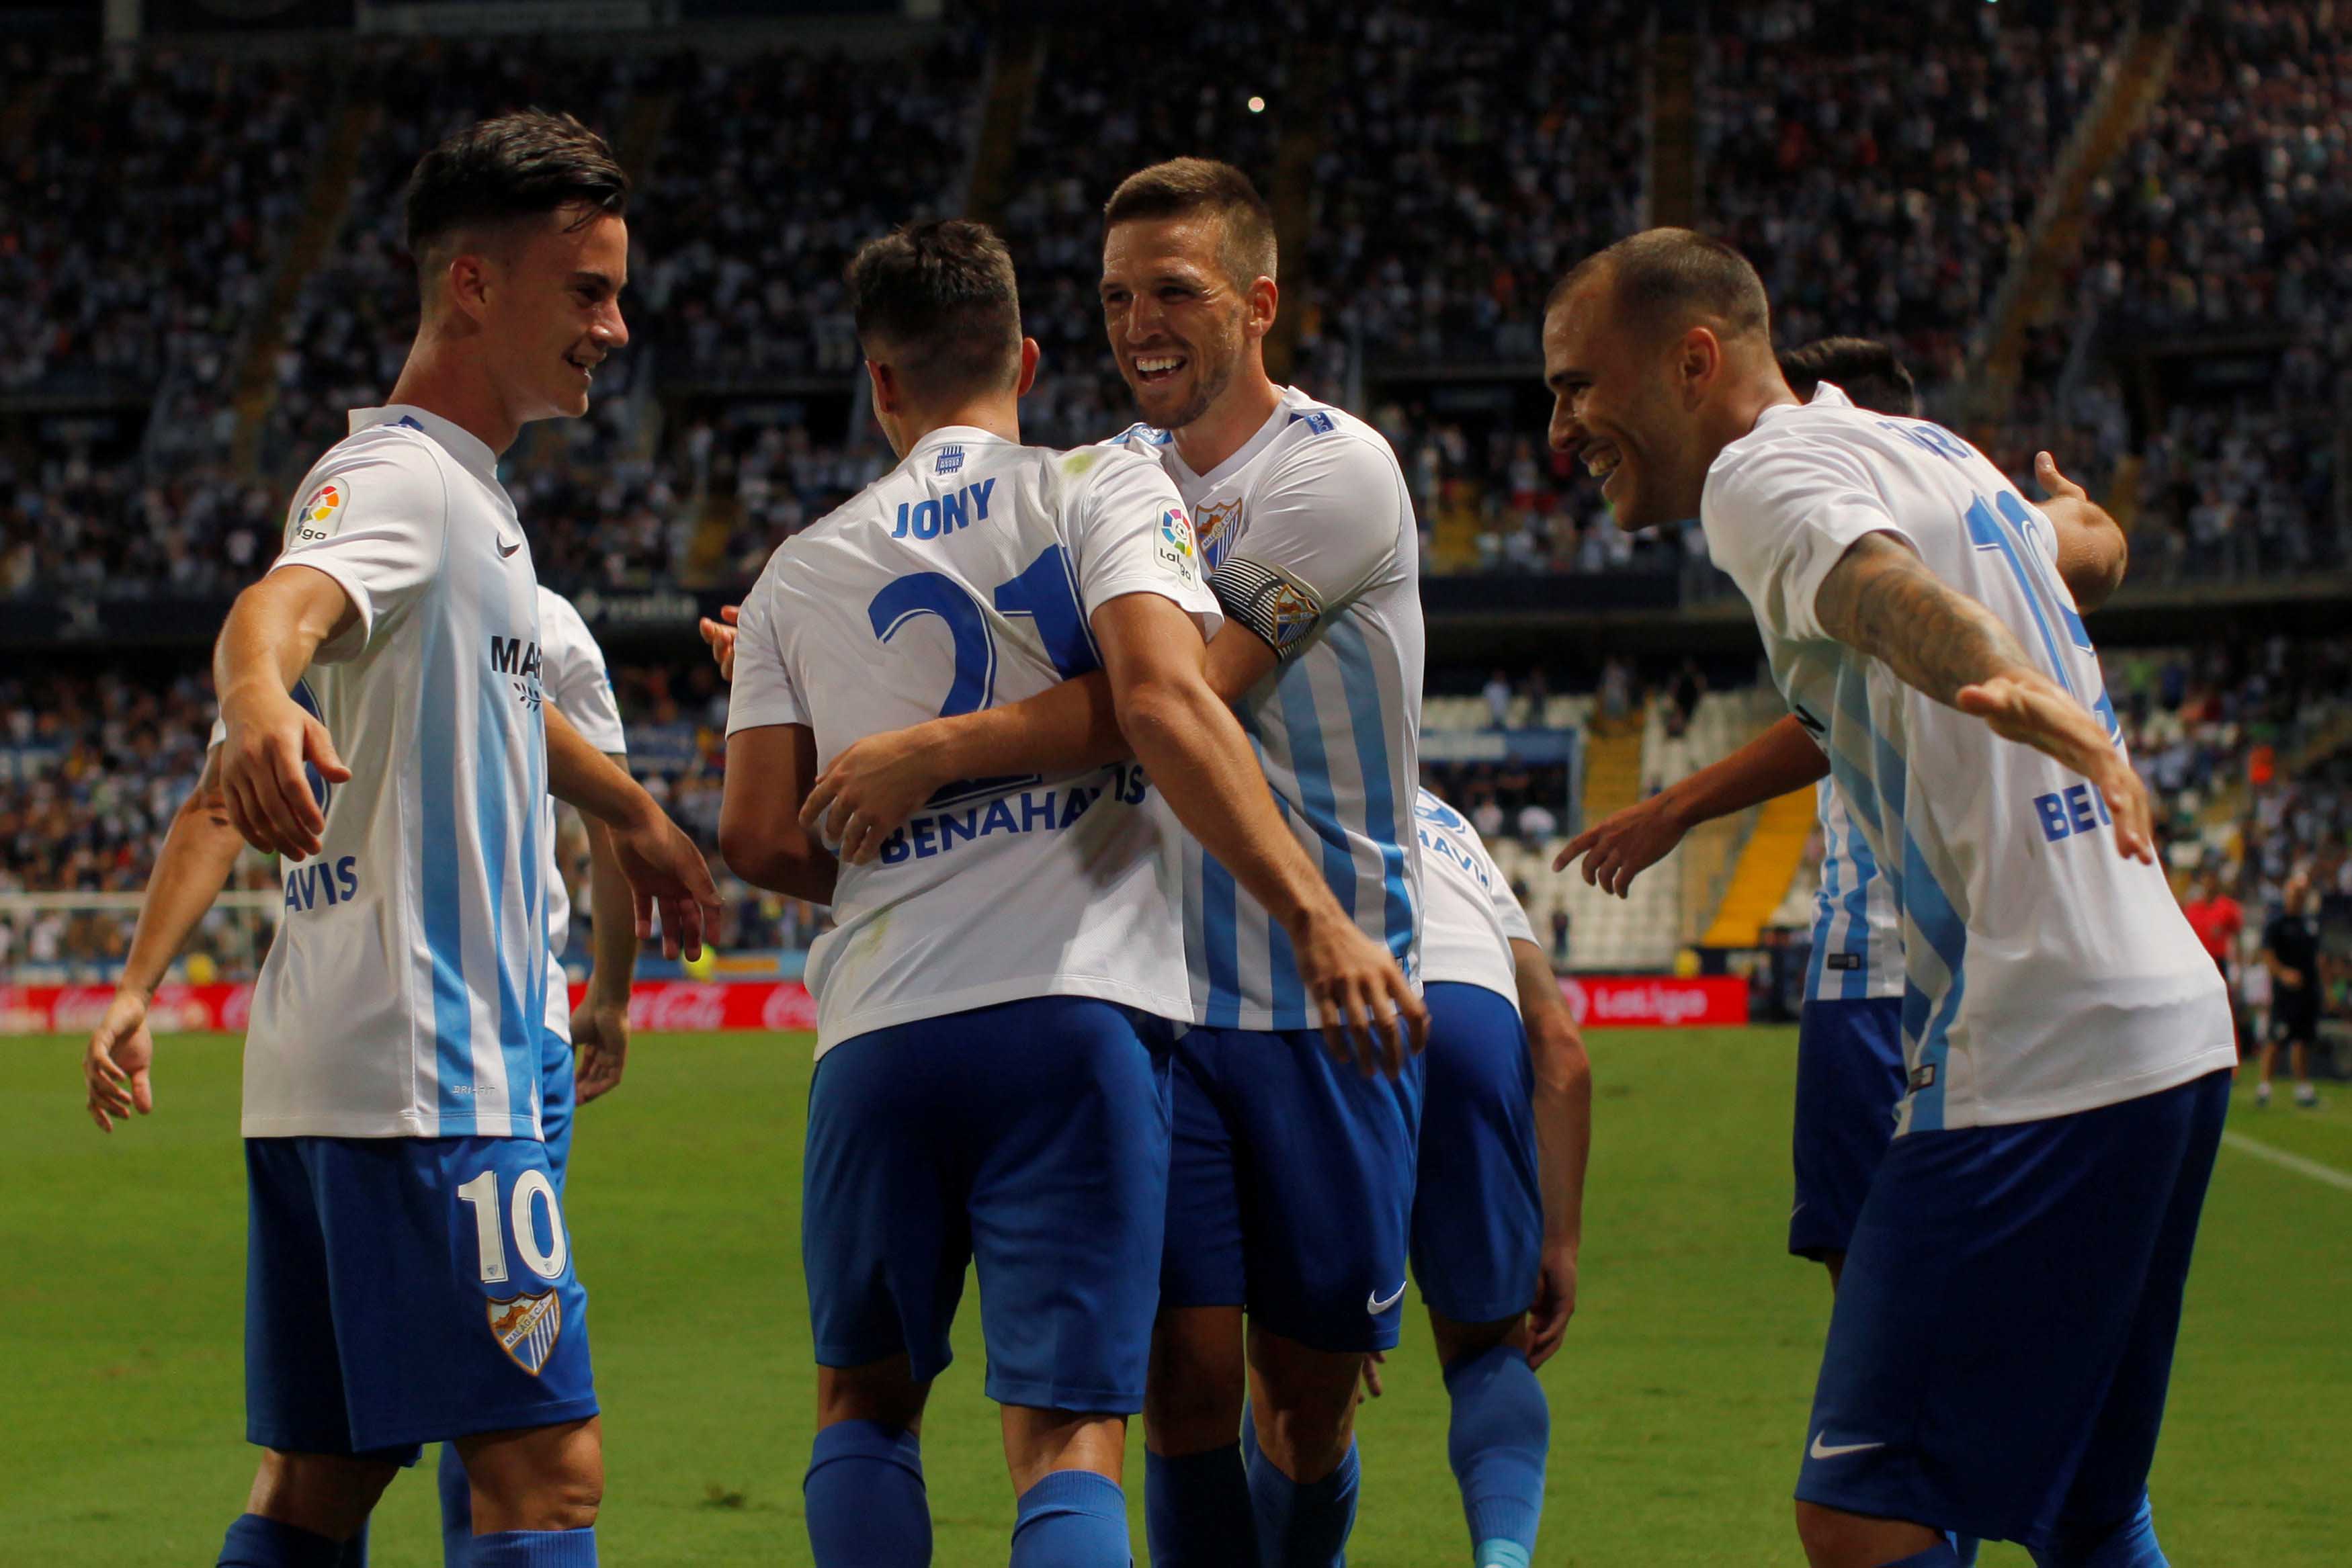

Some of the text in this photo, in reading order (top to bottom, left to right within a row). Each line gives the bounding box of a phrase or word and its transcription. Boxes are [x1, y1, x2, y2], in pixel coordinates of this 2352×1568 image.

[892, 478, 996, 540] JONY
[868, 543, 1124, 810] 21
[457, 1169, 567, 1283] 10
